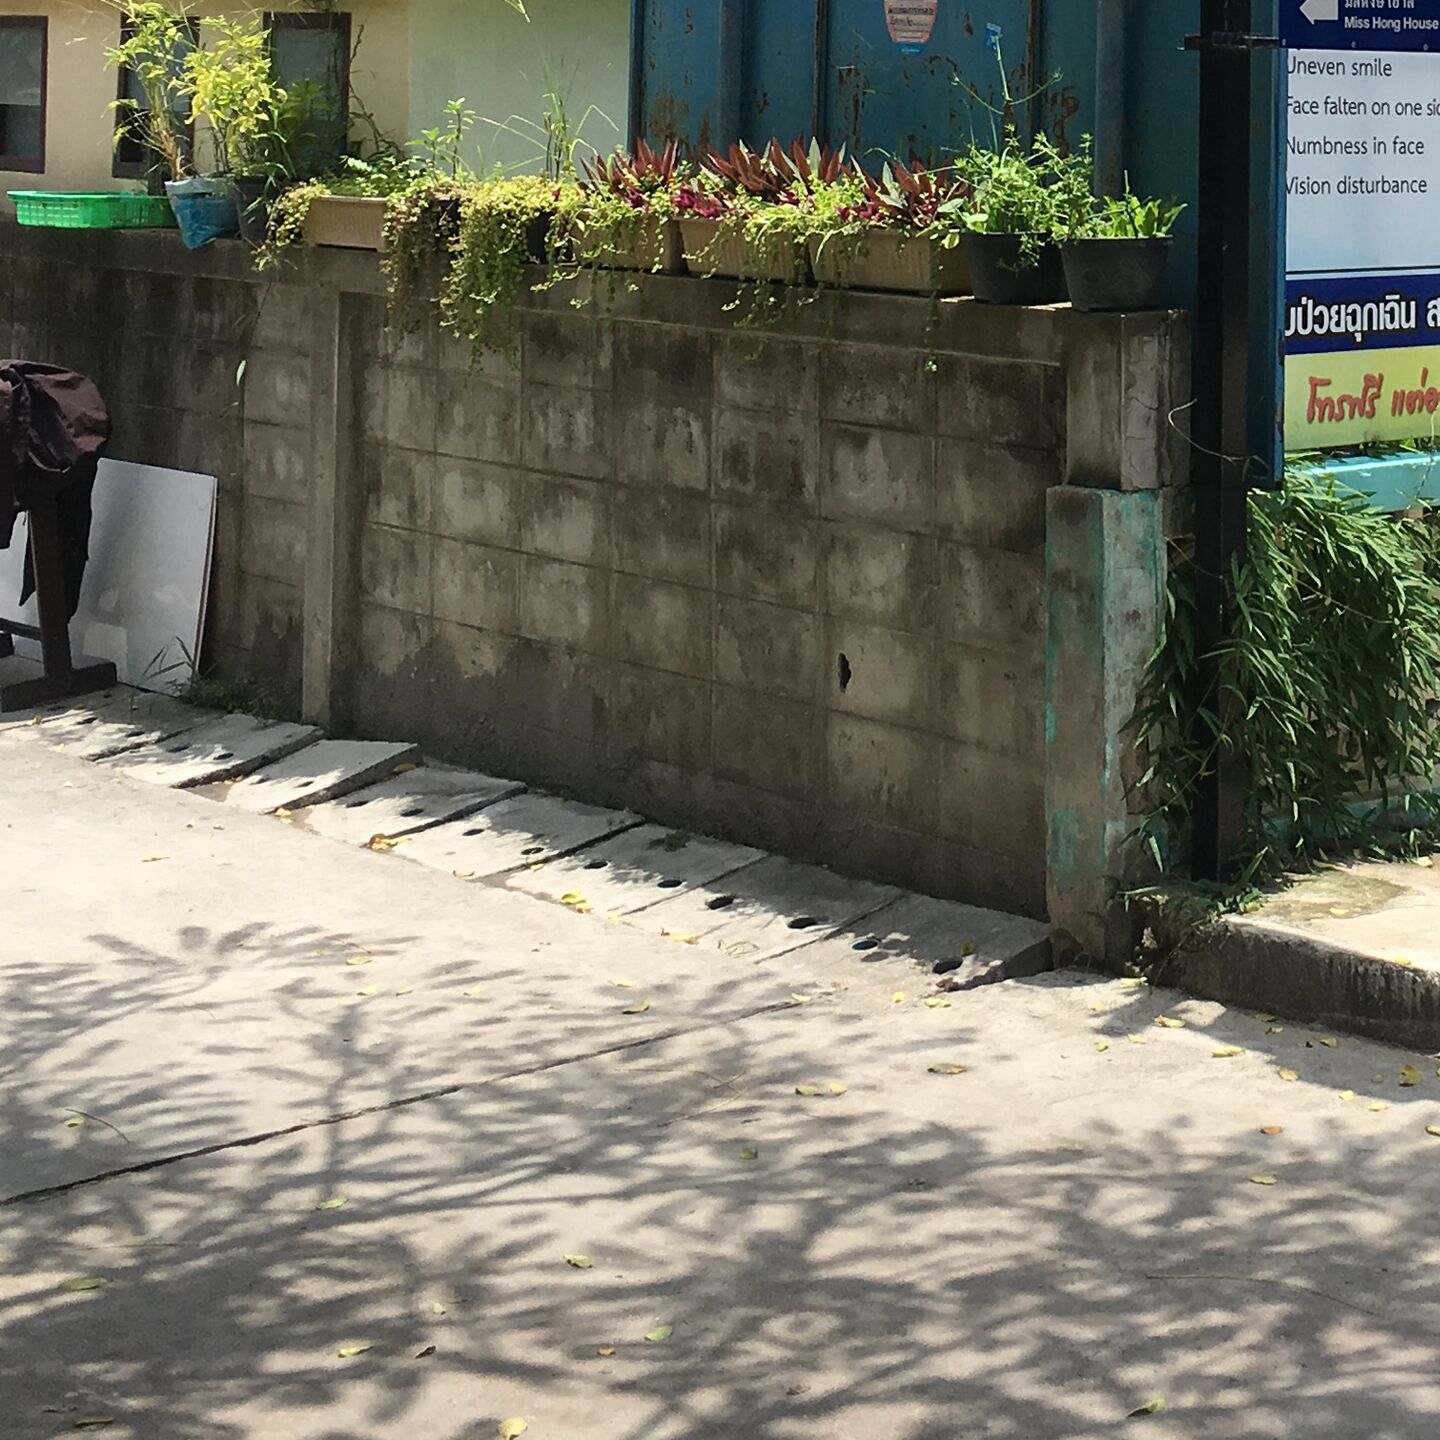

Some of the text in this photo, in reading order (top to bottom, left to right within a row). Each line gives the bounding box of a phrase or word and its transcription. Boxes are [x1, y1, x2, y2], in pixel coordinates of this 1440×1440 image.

[1345, 17, 1439, 33] Miss Hong House
[1352, 58, 1392, 77] smile
[1372, 101, 1390, 115] on
[1395, 100, 1422, 116] one
[1287, 136, 1424, 154] Numbness in face
[1286, 175, 1427, 195] Vision disturbance
[1308, 373, 1384, 423] โทรฟรี
